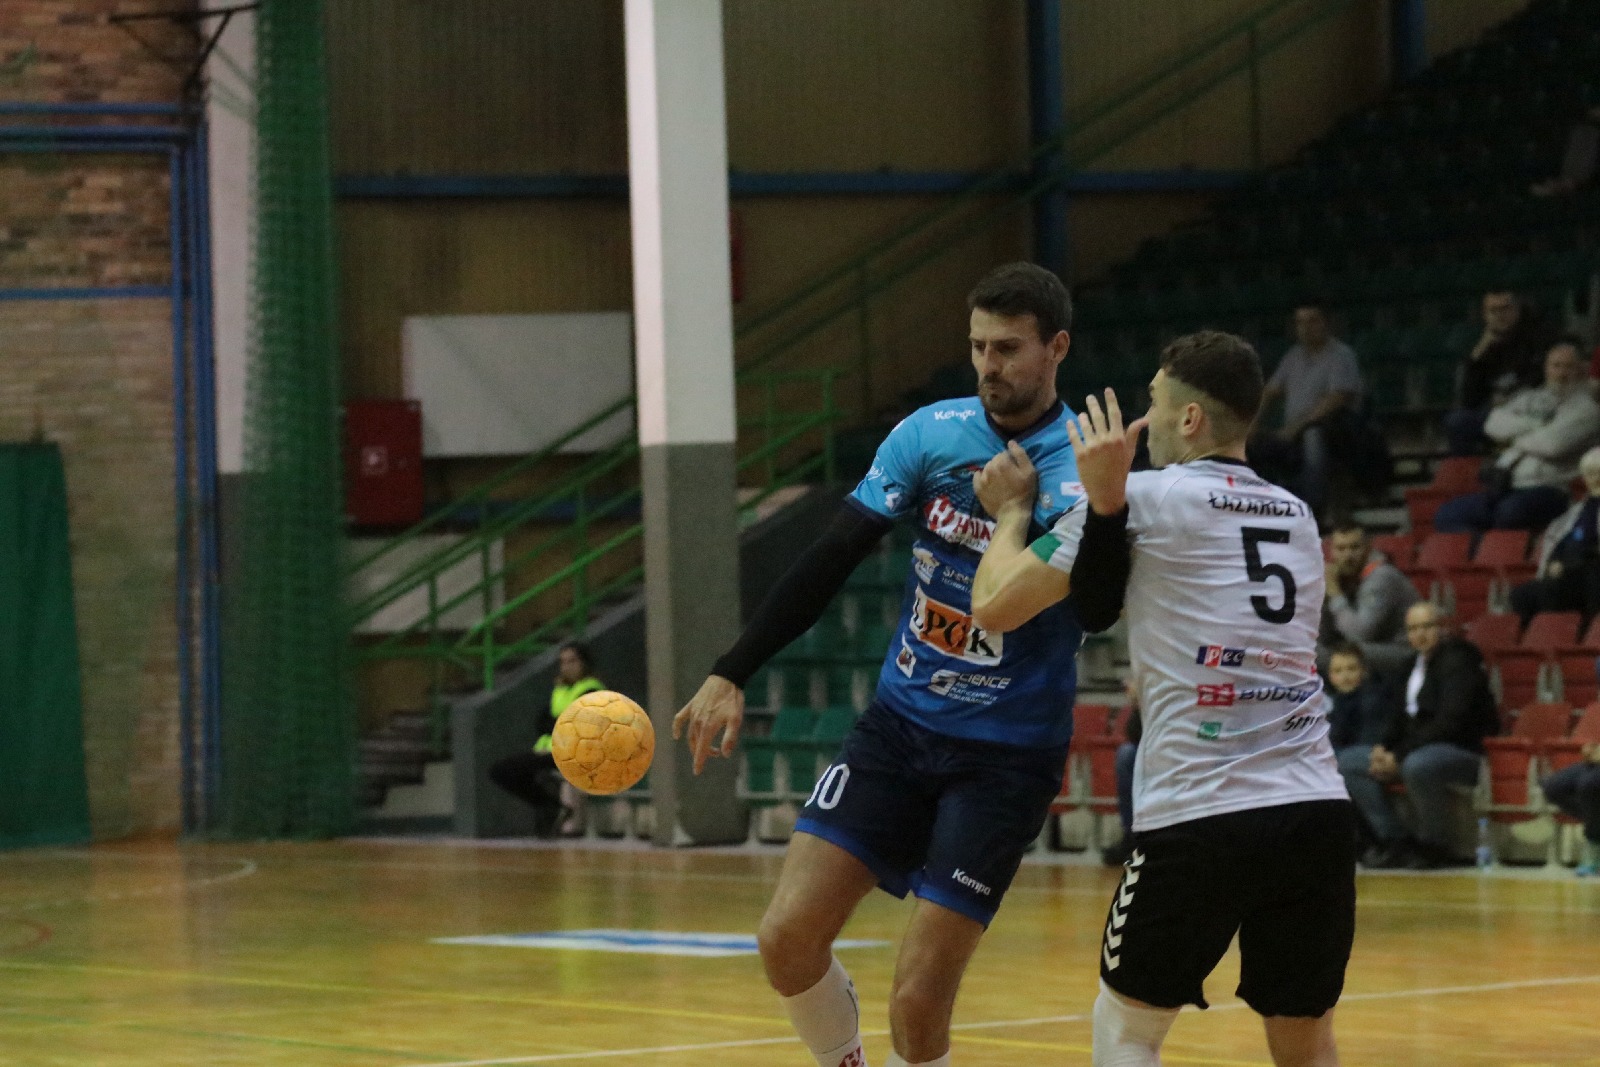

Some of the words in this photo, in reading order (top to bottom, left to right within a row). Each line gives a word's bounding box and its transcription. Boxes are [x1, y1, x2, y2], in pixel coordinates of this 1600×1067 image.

[934, 409, 977, 421] Kempa
[1241, 526, 1297, 624] 5
[951, 867, 992, 896] Kempa
